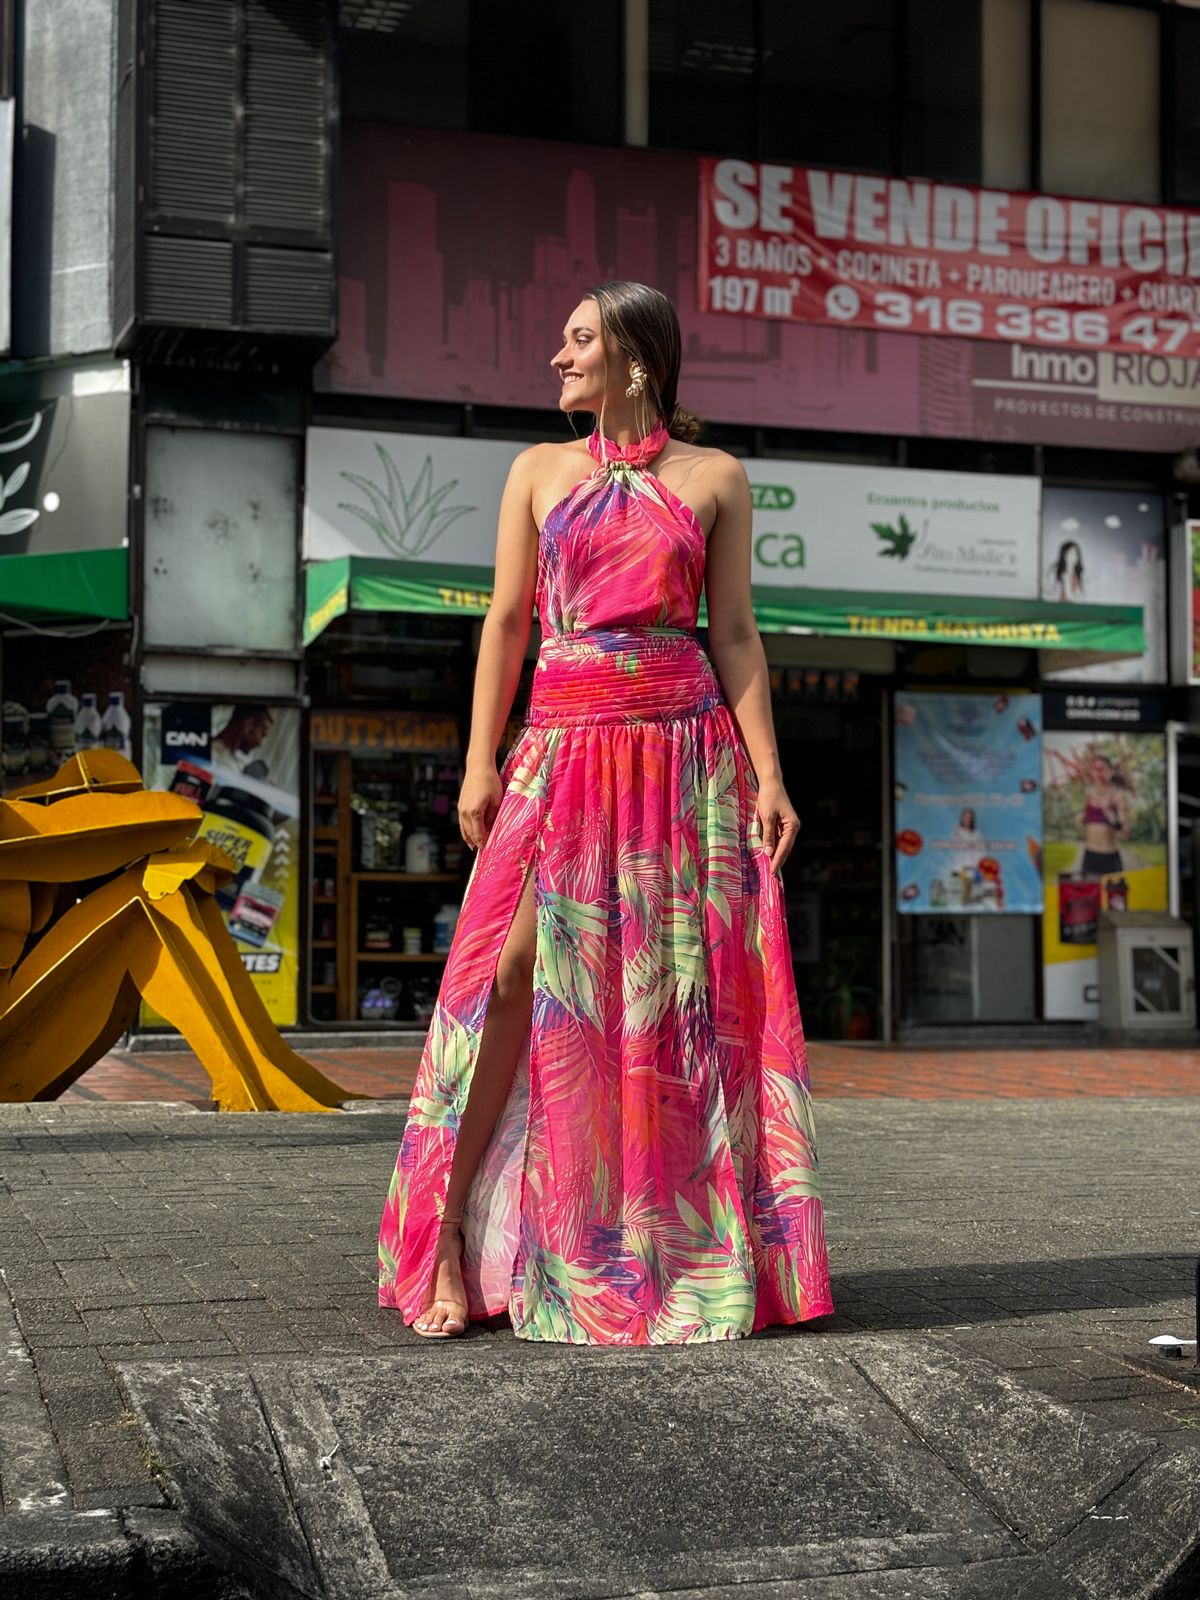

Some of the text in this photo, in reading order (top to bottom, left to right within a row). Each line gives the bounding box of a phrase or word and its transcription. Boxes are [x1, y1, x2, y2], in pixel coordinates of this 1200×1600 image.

[713, 158, 793, 234] SE
[807, 169, 1010, 257] VENDE
[715, 235, 731, 268] 3
[736, 236, 814, 276] BAÑOS
[836, 250, 942, 289] COCINETA
[967, 263, 1117, 306] PARQUEADERO
[710, 275, 759, 313] 197
[874, 292, 983, 335] 316
[995, 304, 1109, 346] 336
[1121, 316, 1200, 351] 47
[1011, 343, 1096, 384] Inmo
[992, 398, 1200, 427] PROYECTOS DE CONSTRU
[755, 532, 806, 571] ca
[848, 615, 929, 635] TIENDA
[243, 954, 280, 973] TES
